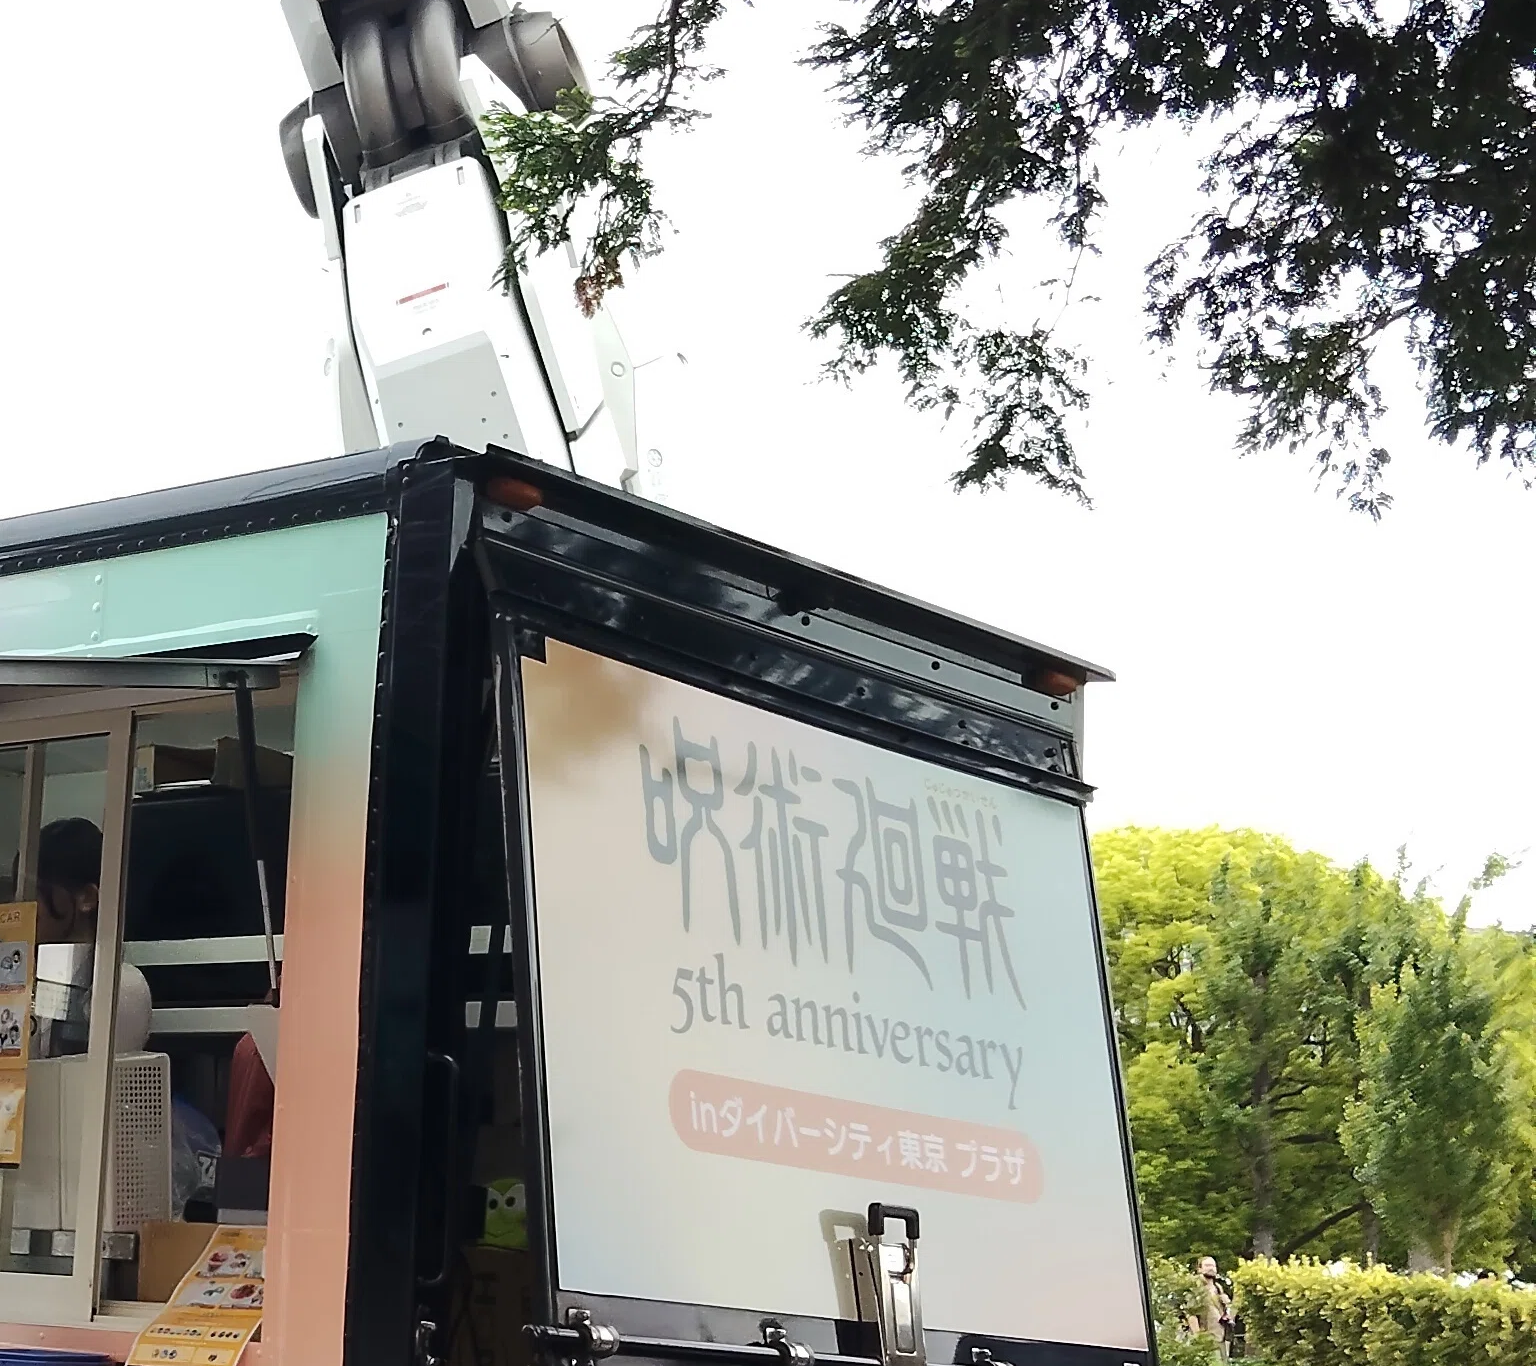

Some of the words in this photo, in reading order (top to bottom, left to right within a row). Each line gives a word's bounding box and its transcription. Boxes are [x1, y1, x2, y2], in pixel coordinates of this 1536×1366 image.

[638, 714, 1028, 1012] 呪術廻戦
[670, 951, 751, 1035] 5th
[766, 990, 1024, 1111] anniversary
[954, 1137, 1028, 1186] プラザ
